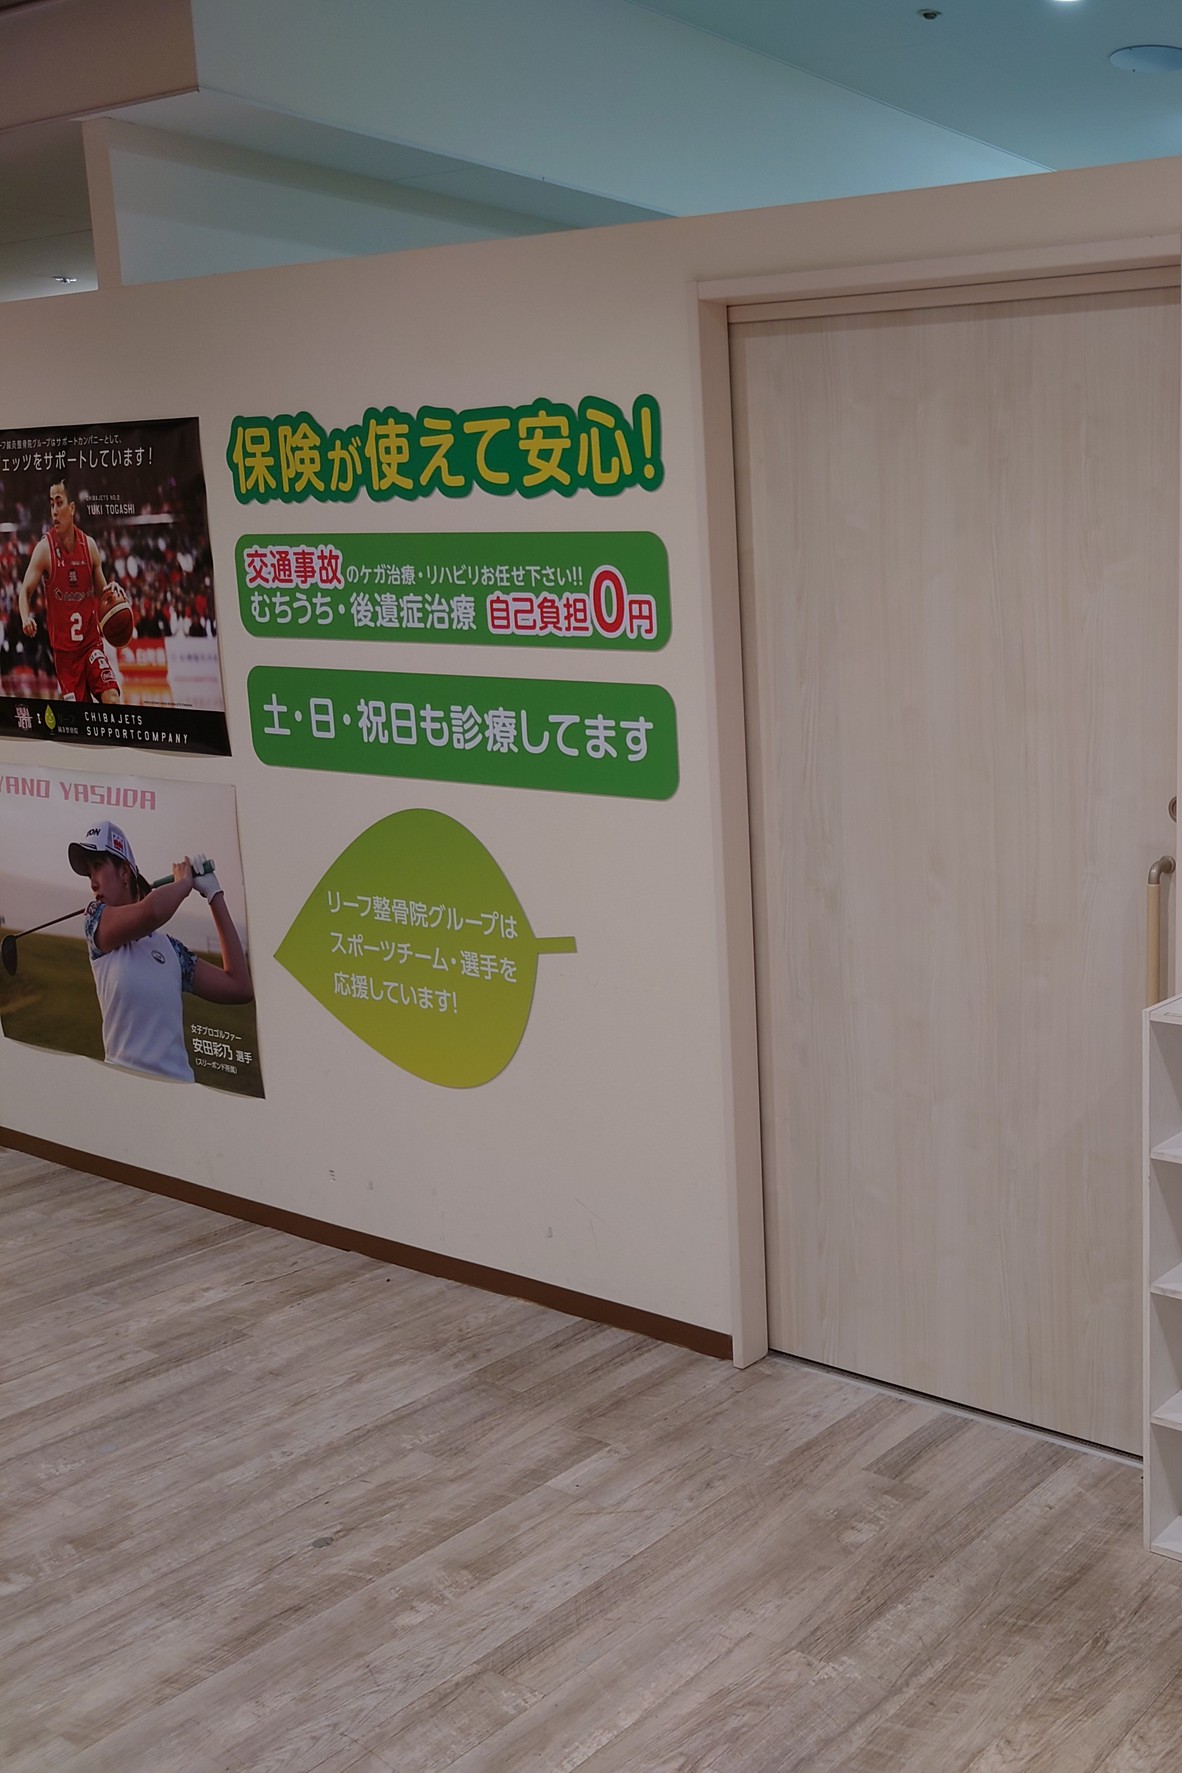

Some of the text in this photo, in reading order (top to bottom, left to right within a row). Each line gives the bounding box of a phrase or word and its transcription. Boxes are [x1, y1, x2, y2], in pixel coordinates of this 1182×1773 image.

[230, 404, 658, 495] 保険が使えて安心!
[87, 503, 136, 515] YUKI TOGASHI
[250, 567, 655, 638] むちうち・後遺症治療 自己負担0円
[69, 612, 84, 641] 2
[84, 711, 143, 726] CHIBAJETS
[263, 692, 655, 762] 土・日・祝日も診療してます
[86, 726, 189, 744] SUPPORTCOMPANY
[59, 781, 157, 810] YASUDA
[327, 890, 519, 940] リーフ整骨院グループは
[330, 931, 518, 984] スポーツチーム・選手を
[333, 971, 459, 1014] 応援しています!
[191, 1024, 242, 1041] 女子プロゴルファー
[192, 1038, 253, 1064] 安田彩乃 選手
